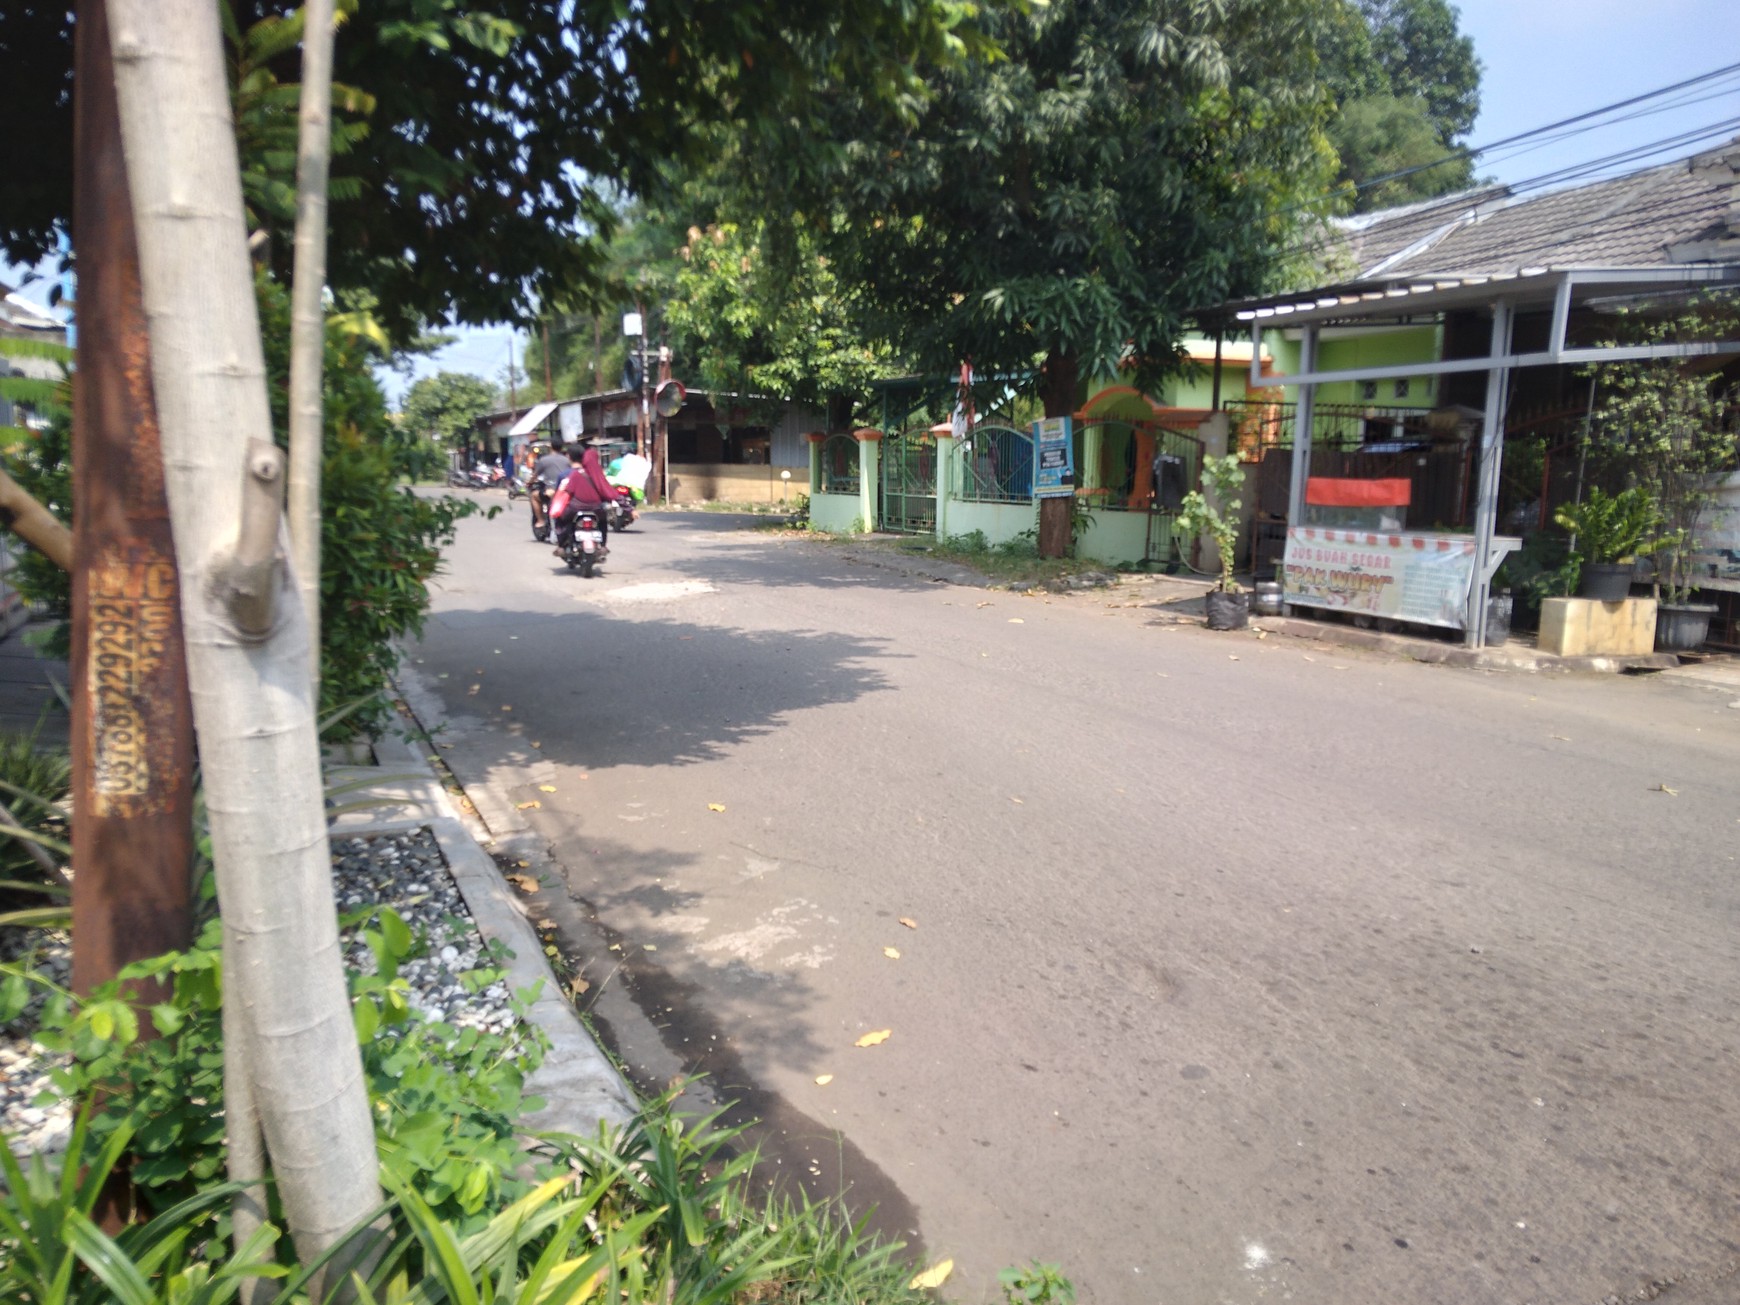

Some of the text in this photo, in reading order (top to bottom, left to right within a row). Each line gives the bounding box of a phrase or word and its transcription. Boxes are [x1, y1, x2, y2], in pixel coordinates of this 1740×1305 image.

[1291, 547, 1392, 569] JUS BUAH SEGAR
